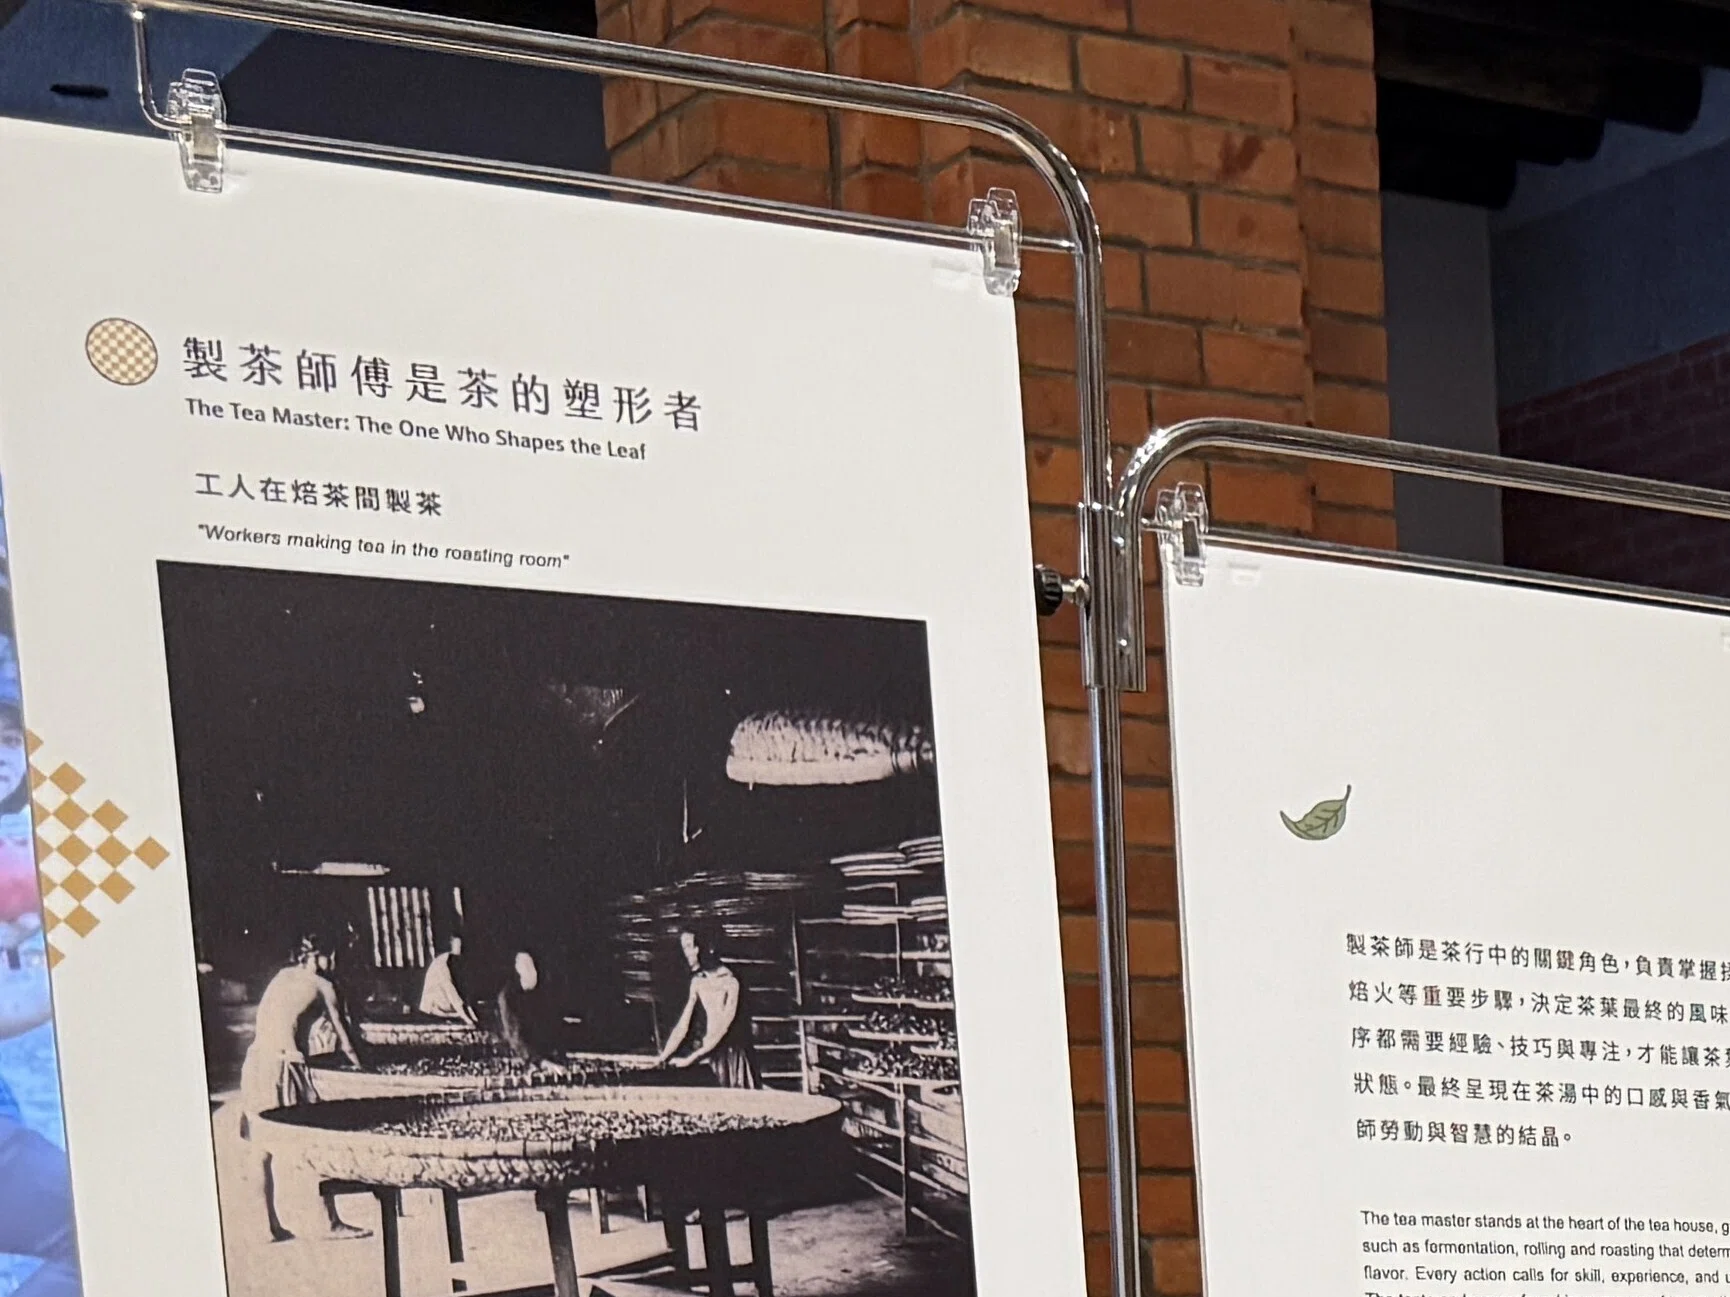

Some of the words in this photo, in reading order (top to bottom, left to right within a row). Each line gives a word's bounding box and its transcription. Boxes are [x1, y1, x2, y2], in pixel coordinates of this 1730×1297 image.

[181, 335, 702, 432] 製茶師傅是茶的塑形者
[183, 396, 224, 419] The
[227, 401, 266, 422] Tea
[271, 405, 350, 431] Master:
[354, 413, 393, 436] The
[397, 418, 440, 440] One
[443, 422, 490, 445] Who
[494, 428, 565, 454] Shapes
[569, 436, 602, 456] the
[606, 439, 646, 461] Leaf
[194, 471, 442, 517] 工人在焙茶間製茶
[286, 532, 352, 555] making
[357, 537, 385, 554] tea
[389, 538, 406, 556] in
[411, 541, 439, 559] the
[444, 546, 514, 568] roasting
[1355, 1117, 1572, 1148] 師勞動與智慧的結晶。
[1359, 1209, 1390, 1226] The
[1392, 1211, 1417, 1227] tea
[1419, 1212, 1472, 1228] master
[1473, 1213, 1522, 1229] stands
[1524, 1215, 1540, 1229] at
[1541, 1214, 1565, 1230] the
[1567, 1214, 1605, 1231] heart
[1606, 1215, 1621, 1231] of
[1623, 1215, 1645, 1232] the
[1647, 1217, 1670, 1232] tea
[1672, 1217, 1718, 1235] house,
[1361, 1237, 1398, 1253] such
[1401, 1240, 1420, 1253] as
[1423, 1237, 1519, 1257] fermentation,
[1522, 1240, 1566, 1260] rolling
[1569, 1241, 1596, 1256] and
[1599, 1241, 1655, 1261] roasting
[1657, 1242, 1685, 1258] that
[1362, 1263, 1409, 1281] flavor.
[1414, 1264, 1458, 1285] Every
[1462, 1266, 1507, 1282] action
[1511, 1266, 1545, 1282] calls
[1549, 1266, 1569, 1282] for
[1573, 1266, 1605, 1284] skill,
[1610, 1268, 1689, 1286] experience,
[1694, 1268, 1720, 1284] and
